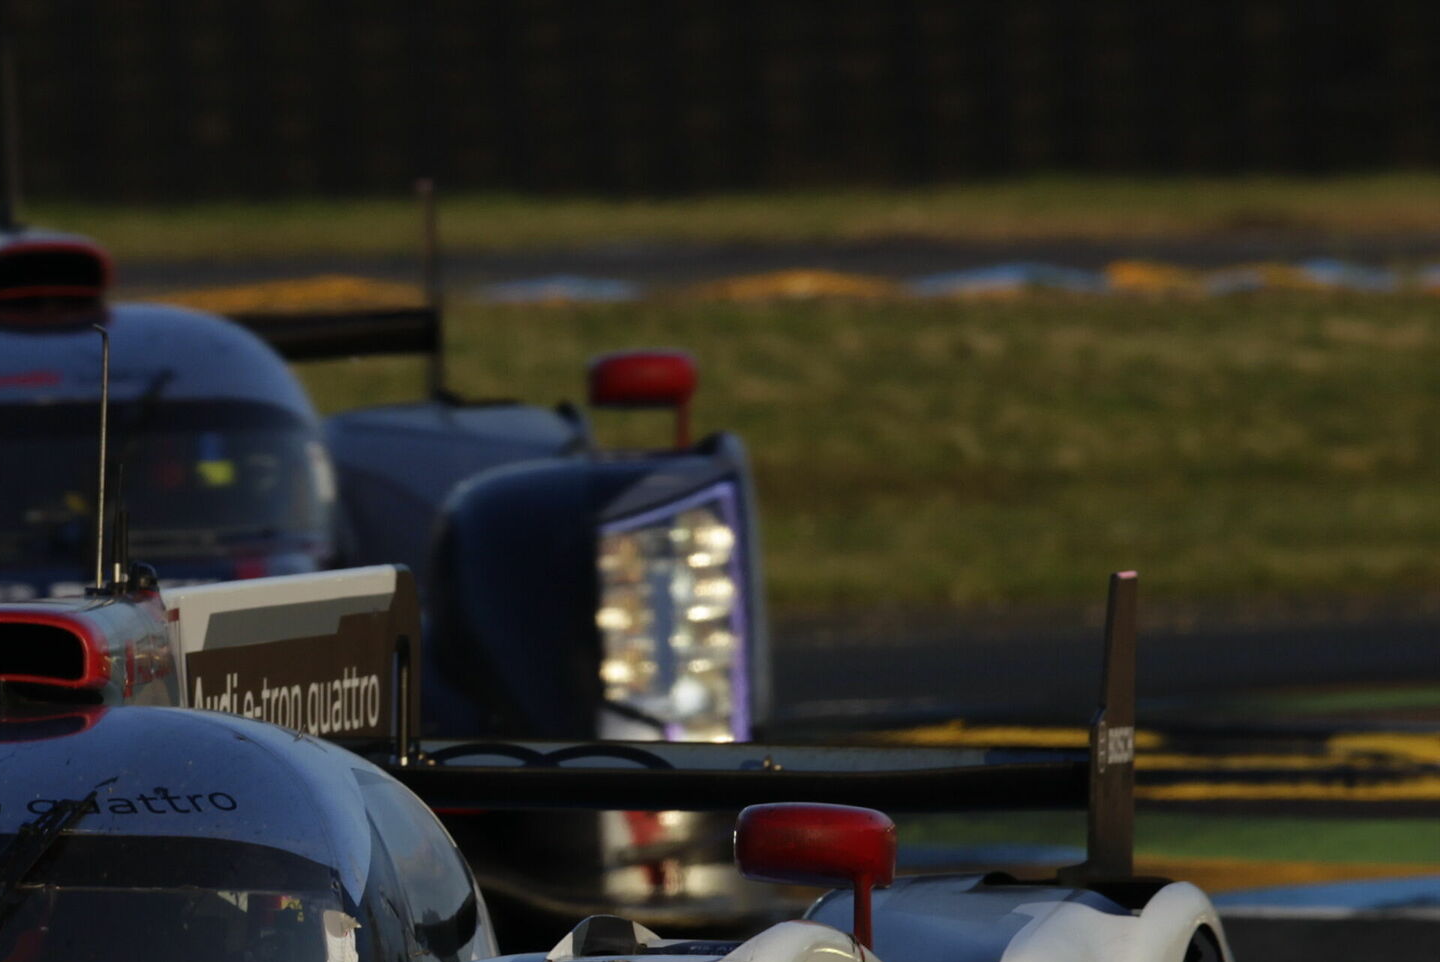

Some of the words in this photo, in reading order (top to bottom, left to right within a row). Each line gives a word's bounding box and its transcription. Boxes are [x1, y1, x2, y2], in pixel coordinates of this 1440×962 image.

[194, 672, 239, 710] Adi
[244, 678, 303, 731] e-tron
[307, 666, 381, 737] quattro
